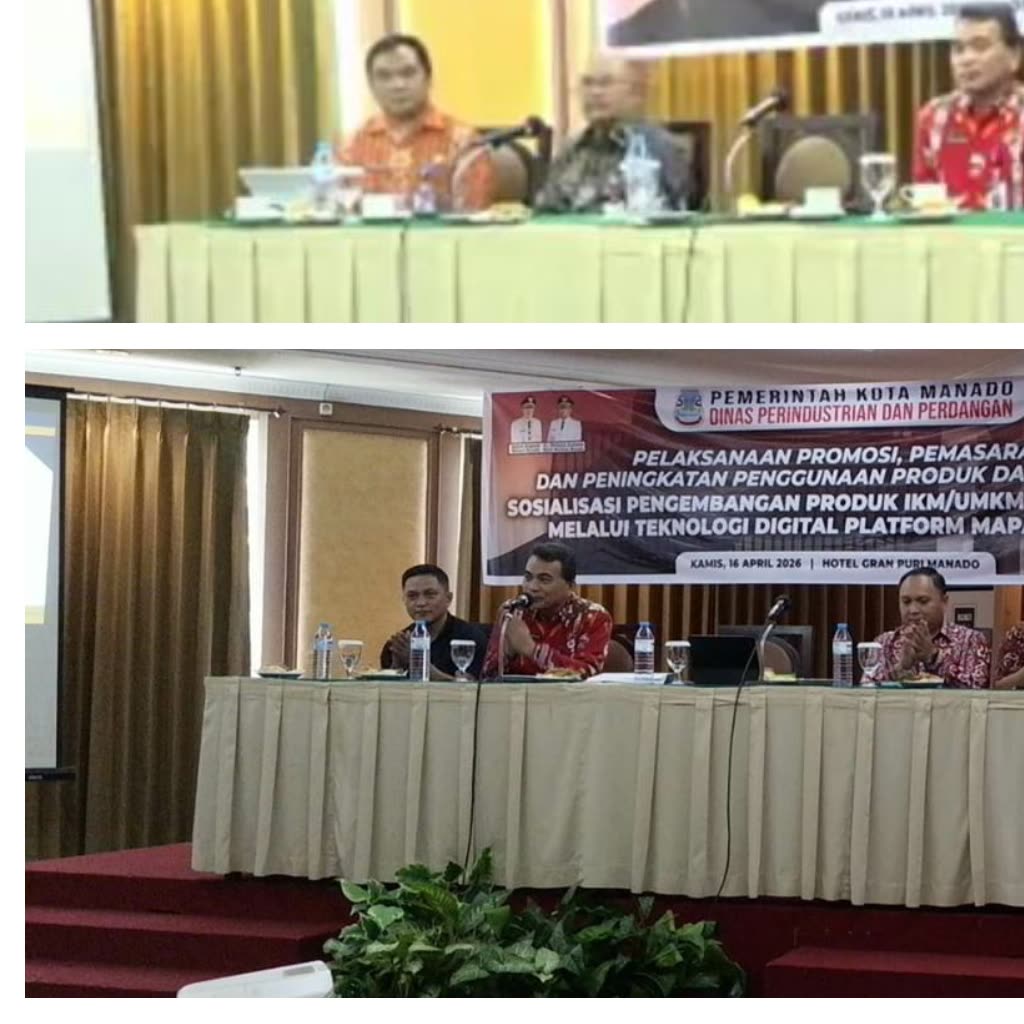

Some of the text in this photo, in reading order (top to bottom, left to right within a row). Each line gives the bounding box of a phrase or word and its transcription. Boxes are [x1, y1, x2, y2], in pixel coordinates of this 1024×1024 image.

[710, 380, 1014, 406] PEMERINTAH KOTA MANADO
[709, 398, 1013, 427] DINAS PERINDUSTRIAN DAN PERDANGAN
[633, 449, 794, 467] PELAKSANAAN
[796, 445, 903, 466] PROMOSI,
[536, 473, 578, 491] DAN
[583, 470, 728, 490] PENINGKATAN
[732, 467, 887, 487] PENGGUNAAN
[890, 465, 990, 485] PRODUK
[507, 496, 622, 518] SOSIALISASI
[626, 494, 801, 515] PENGEMBANGAN
[805, 492, 898, 512] PRODUK
[904, 490, 1024, 513] IKM/UMKM
[548, 520, 630, 539] MELALUI
[635, 518, 749, 537] TEKNOLOGI
[754, 517, 839, 535] DIGITAL
[845, 516, 964, 536] PLATFORM
[690, 558, 980, 570] KAMIS, 16 APRIL 2026 HOTEL GRAN PURI MANADO
